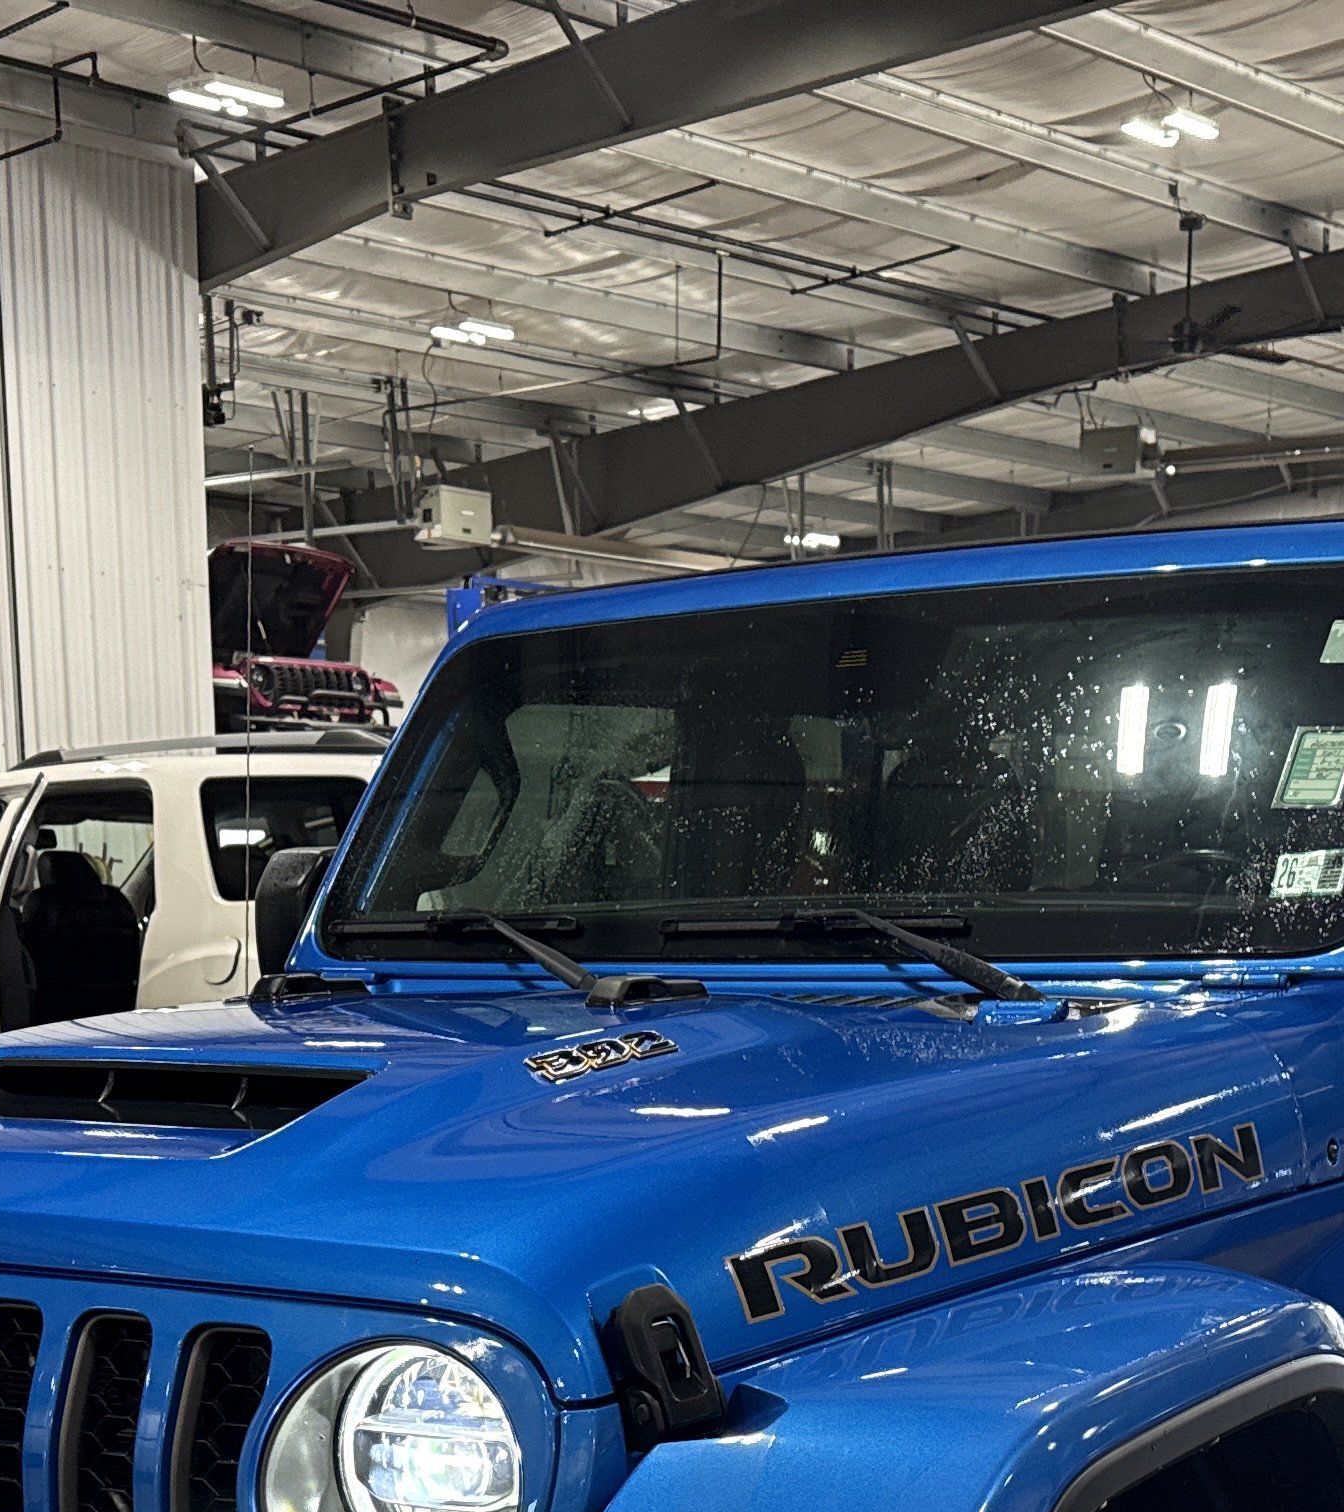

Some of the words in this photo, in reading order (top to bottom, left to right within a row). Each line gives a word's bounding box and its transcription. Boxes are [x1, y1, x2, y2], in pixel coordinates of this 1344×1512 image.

[1277, 858, 1299, 889] 26
[523, 1030, 680, 1083] 392
[724, 1122, 1266, 1324] RUBICON
